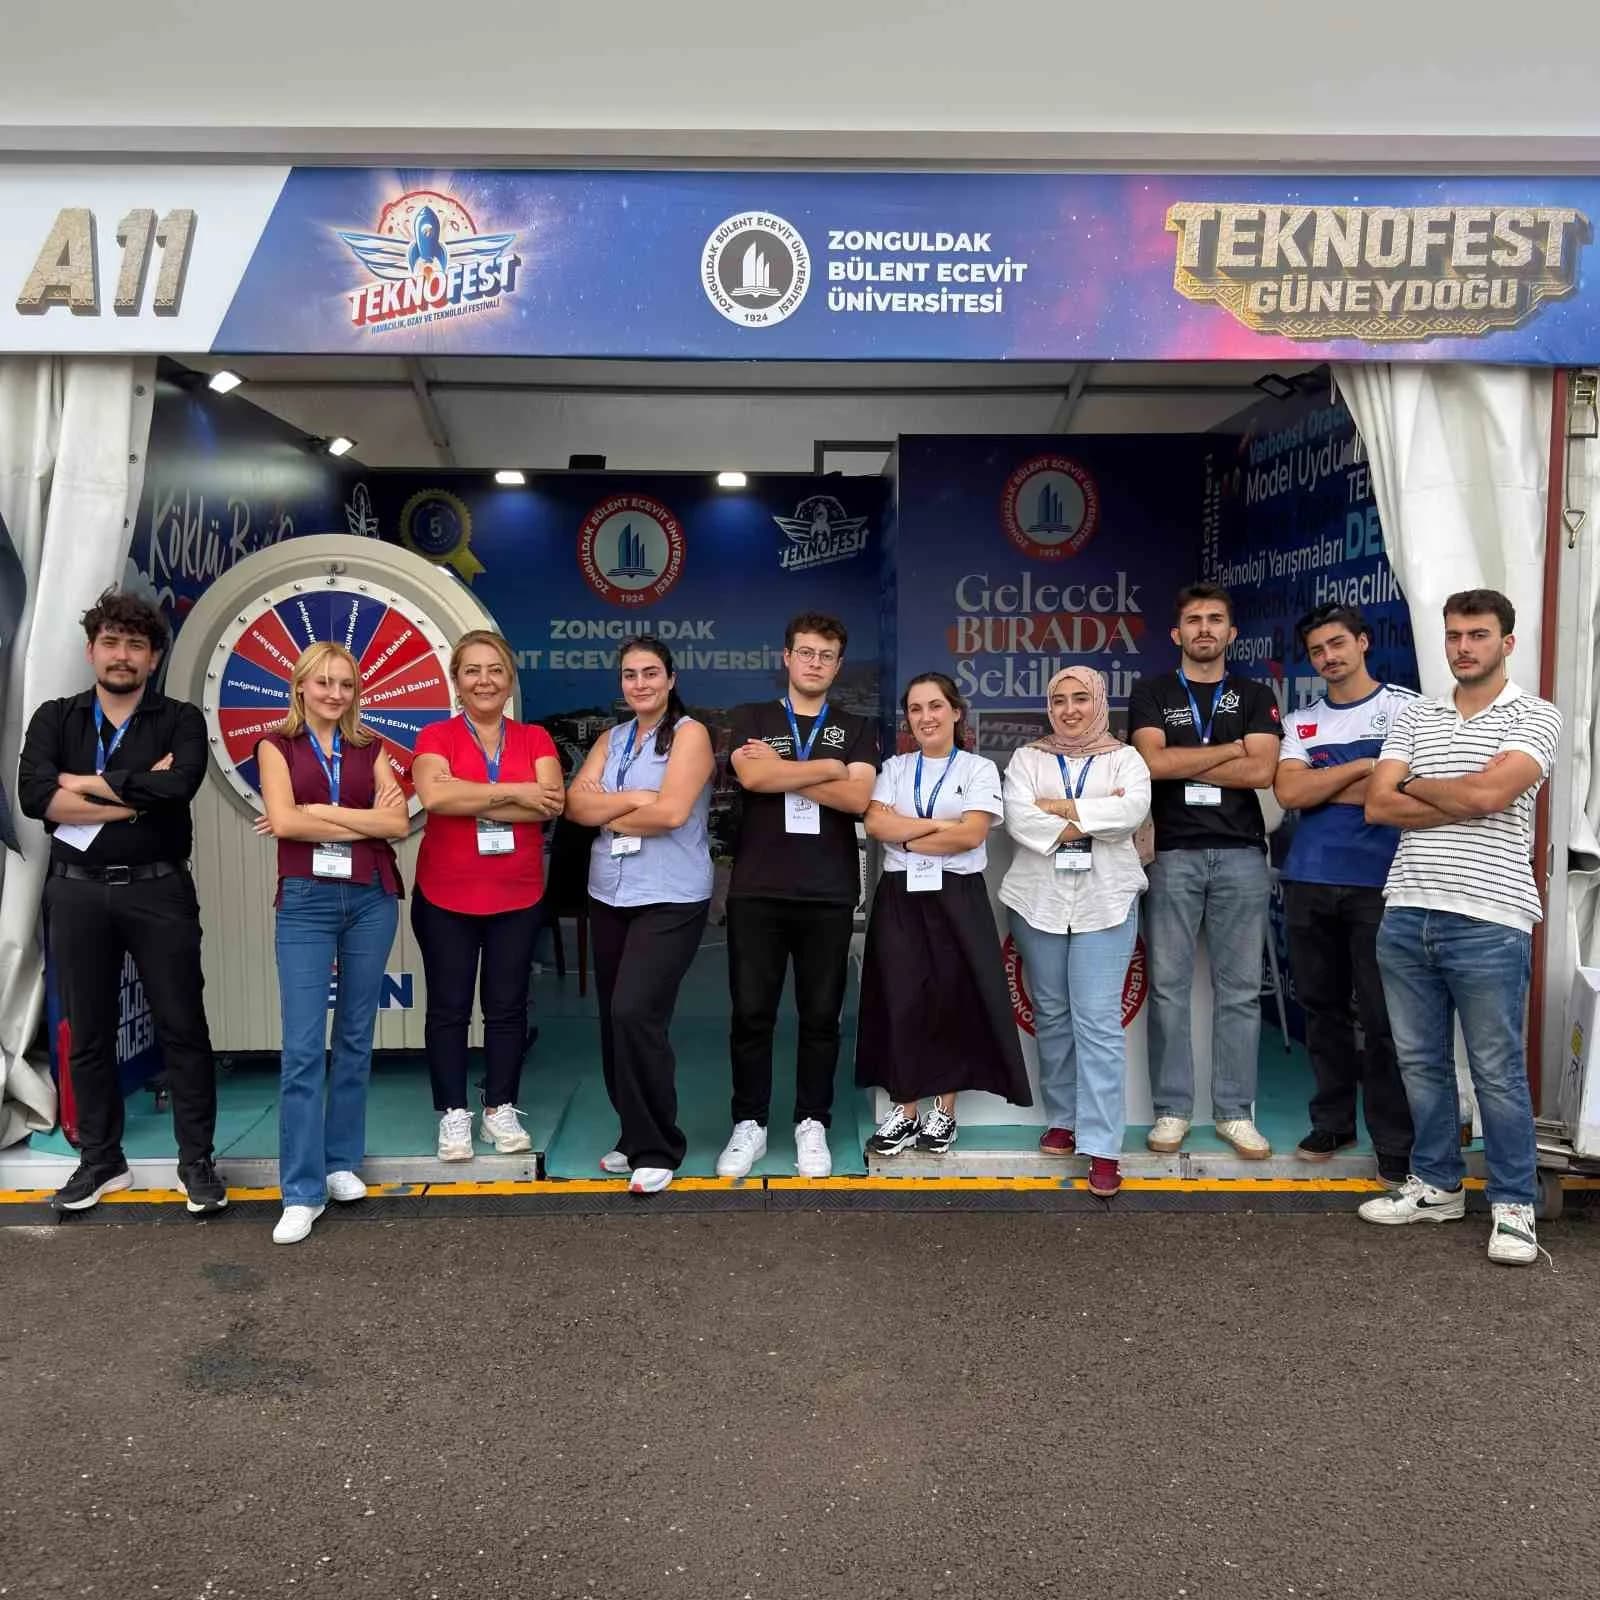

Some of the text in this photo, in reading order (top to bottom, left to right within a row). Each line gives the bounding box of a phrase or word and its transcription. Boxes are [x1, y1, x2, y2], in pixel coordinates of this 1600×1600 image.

[828, 231, 991, 252] ZONGULDAK
[1170, 206, 1580, 270] TEKNOFEST
[16, 207, 197, 316] A11
[706, 217, 807, 314] ZONGULDAK BÜLENT ECEVİT ÜNİVERSİTESİ
[828, 257, 1028, 282] BÜLENT ECEVİT
[348, 254, 522, 327] TEKNOFEST
[828, 286, 1003, 313] ÜNİVERSİTESİ
[1249, 274, 1519, 313] GÜNEYDOĞU
[744, 313, 769, 322] 1924
[1246, 457, 1294, 507] Model
[1345, 505, 1385, 560] DE
[1216, 533, 1344, 589] Teknoloji Yarışmaları
[620, 594, 645, 603] 1924
[955, 571, 1143, 614] Gelecek
[1315, 560, 1401, 609] Havacılık
[550, 620, 716, 640] ZONGULDAK
[954, 615, 1142, 655] BURADA
[361, 628, 413, 681] Dahaki Bahara
[1225, 637, 1273, 667] ovasyon
[373, 685, 406, 704] Dahaki
[407, 676, 440, 693] Bahara
[387, 719, 409, 730] BEUN
